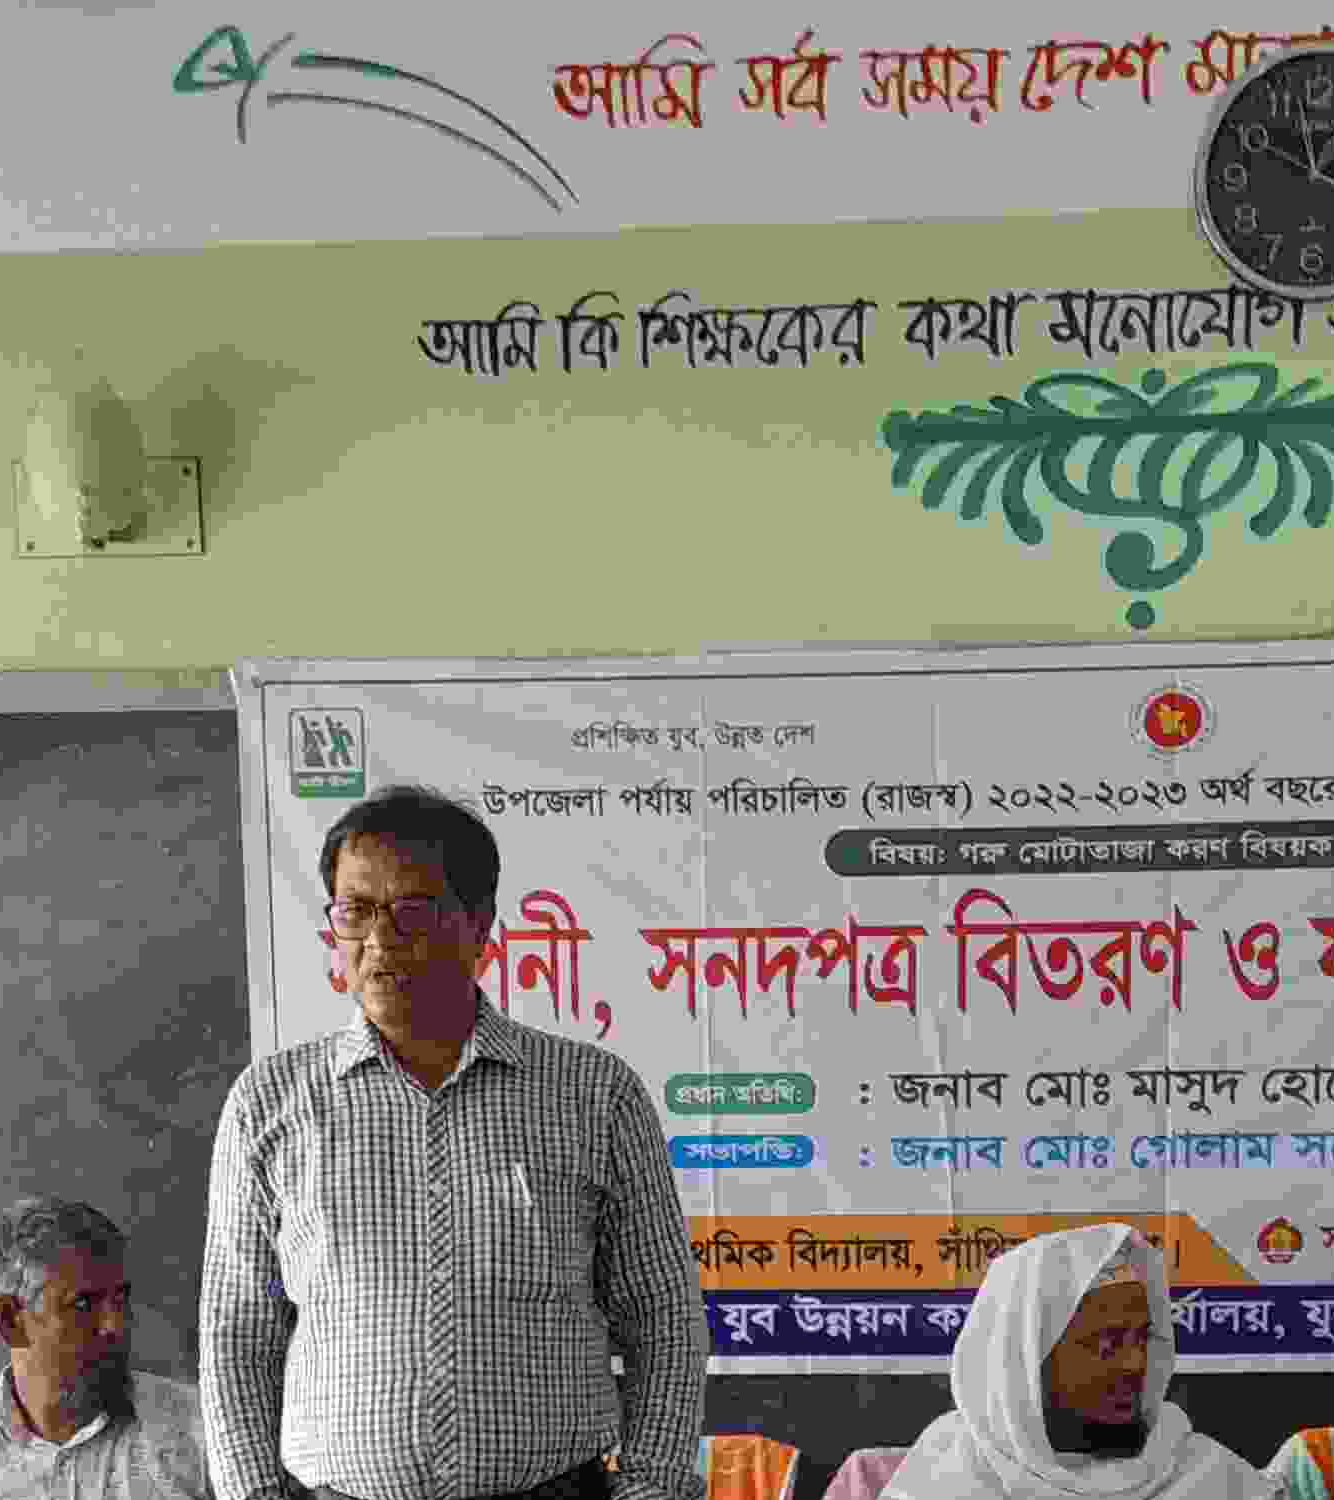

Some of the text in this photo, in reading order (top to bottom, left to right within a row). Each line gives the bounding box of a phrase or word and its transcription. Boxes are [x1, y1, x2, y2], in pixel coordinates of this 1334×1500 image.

[553, 34, 716, 128] আমি
[734, 26, 842, 121] সর্ব
[859, 44, 1009, 125] সময়
[1020, 32, 1170, 111] দেশ
[1306, 75, 1334, 107] 12
[1268, 88, 1290, 118] 11
[1237, 122, 1268, 151] 10
[1220, 163, 1248, 192] 9
[1235, 204, 1257, 232] 8
[1261, 233, 1283, 264] 7
[1299, 244, 1323, 274] 6
[417, 301, 545, 376] আমি
[556, 290, 625, 372] কি
[637, 292, 878, 368] শিক্ষকের
[896, 292, 1038, 359] কথা
[1044, 281, 1308, 358] মনোযোগ
[570, 721, 660, 752] প্রশিক্ষিত
[714, 720, 765, 752] উন্নত
[772, 722, 817, 750] দেশ
[482, 783, 605, 817] উপজেলা
[618, 778, 693, 817] পর্যায়
[706, 776, 851, 817] পরিচালিত
[861, 779, 974, 822] (রাজস্ব)
[988, 777, 1188, 815] ২০২২-২০২৩
[1198, 766, 1257, 808] অর্থ
[957, 840, 1011, 866] গরু
[1019, 832, 1155, 867] মোটাতাজা
[1165, 836, 1229, 864] করণ
[1241, 829, 1334, 861] বিষয়ক
[638, 912, 929, 1021] সনদপত্র
[945, 887, 1201, 1016] বিতরণ
[1223, 920, 1282, 1002] ও
[888, 1068, 1010, 1110] জনাব
[1025, 1067, 1112, 1109] মোঃ
[1126, 1066, 1247, 1118] মাসুদ
[888, 1134, 1010, 1175] জনাব
[1025, 1132, 1111, 1170] মোঃ
[1130, 1129, 1280, 1170] গোলাম
[689, 1228, 780, 1273] থমিক
[785, 1227, 925, 1278] বিদ্যালয়,
[715, 1303, 783, 1346] যুব
[788, 1292, 914, 1342] উন্নয়ন
[1170, 1287, 1287, 1340] র্যালয়,
